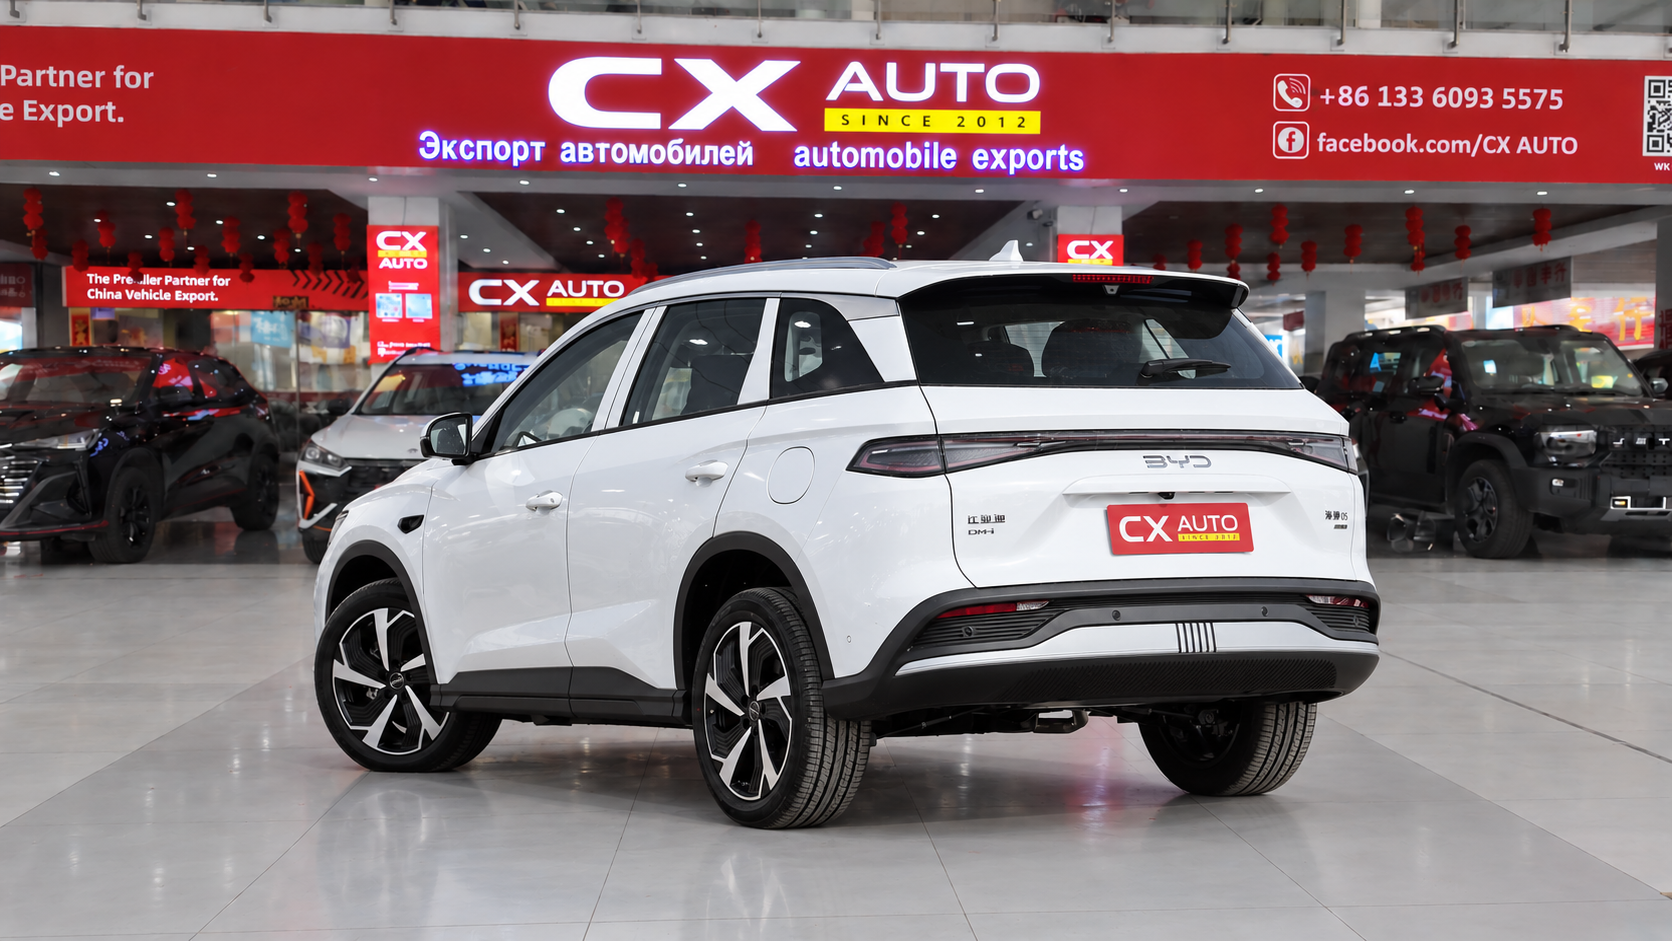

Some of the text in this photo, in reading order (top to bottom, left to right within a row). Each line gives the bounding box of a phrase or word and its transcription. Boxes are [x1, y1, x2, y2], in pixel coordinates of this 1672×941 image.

[0, 64, 154, 89] Partner for
[825, 61, 1041, 103] AUTO
[547, 56, 801, 131] CX
[1319, 85, 1563, 110] +86 133 6093 5575
[23, 100, 124, 128] Export.
[841, 113, 1026, 129] SINCE 2012
[418, 130, 754, 168] Экспорт автомобилей
[1317, 132, 1578, 158] facebook.com/CX AUTO
[794, 141, 1085, 175] automobile exports
[1654, 162, 1670, 171] WK
[376, 231, 427, 252] CX
[1066, 240, 1114, 259] CX
[378, 257, 428, 269] AUTO
[86, 273, 231, 287] The Preier Partner for
[547, 280, 625, 297] AUTO
[86, 288, 219, 303] China Vehicle Export.
[468, 278, 540, 306] CX
[1143, 455, 1212, 469] BYD
[1119, 515, 1173, 542] CX
[1177, 515, 1238, 532] AUTO
